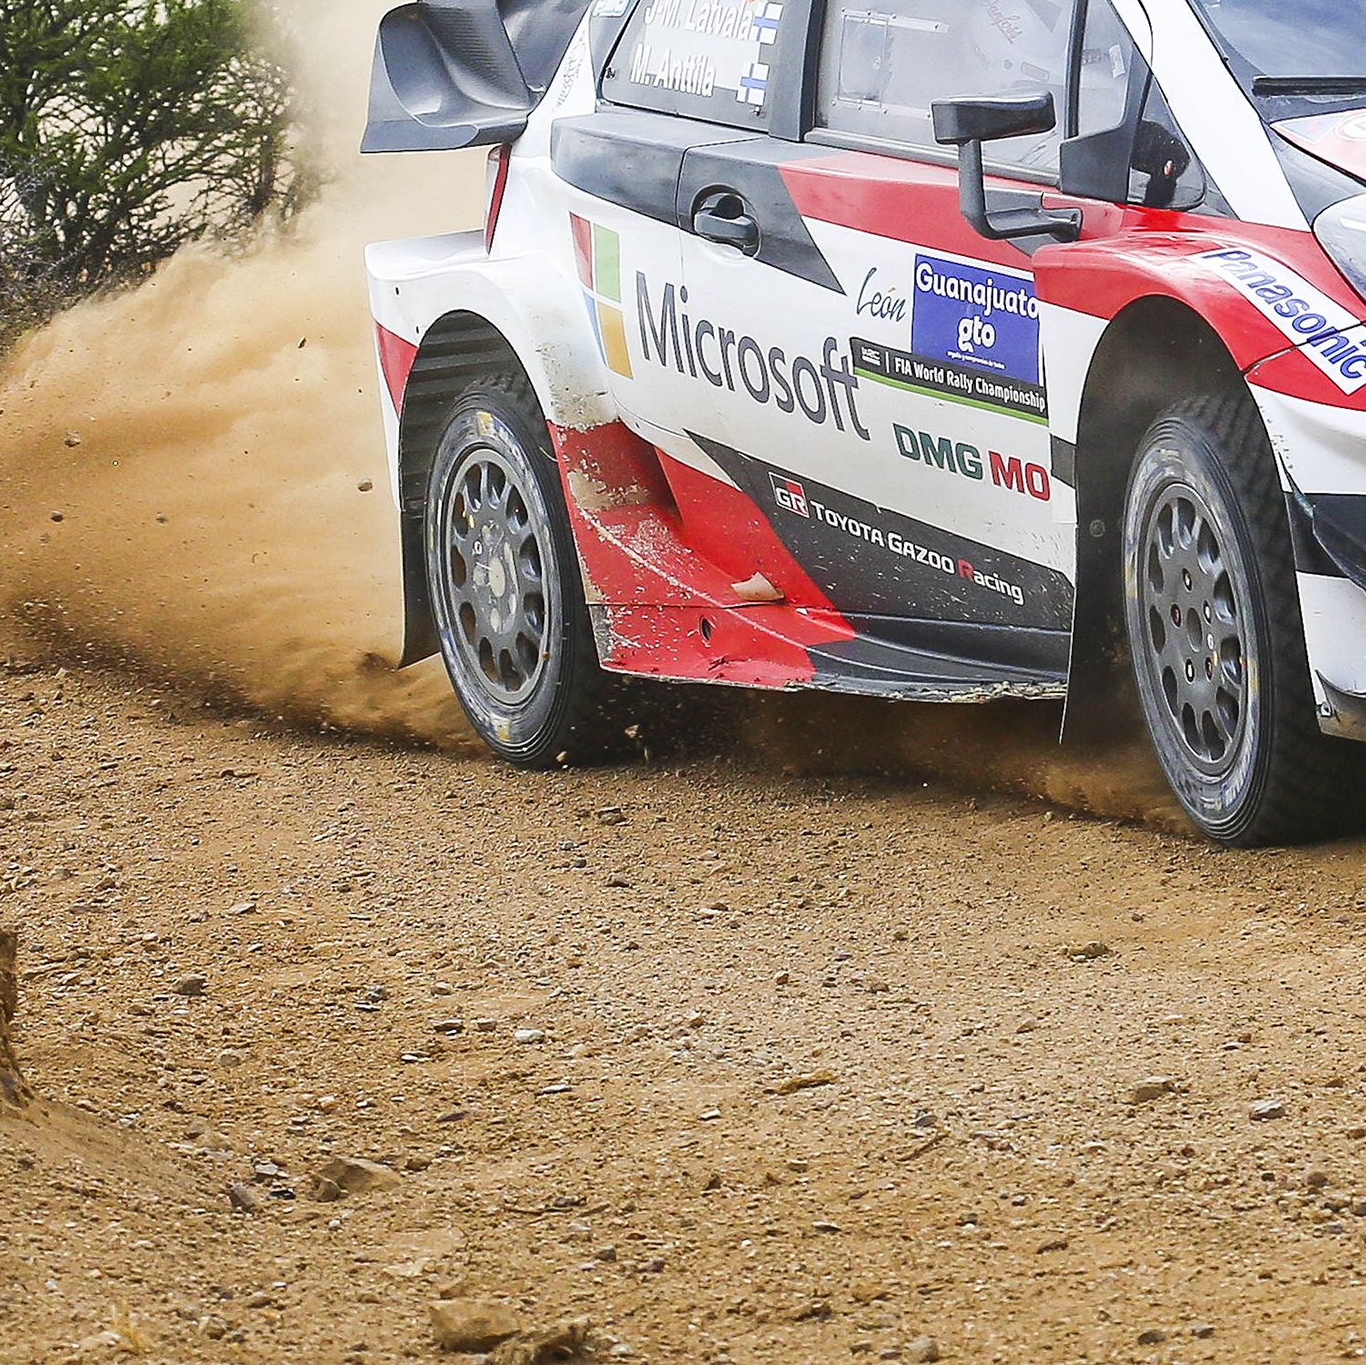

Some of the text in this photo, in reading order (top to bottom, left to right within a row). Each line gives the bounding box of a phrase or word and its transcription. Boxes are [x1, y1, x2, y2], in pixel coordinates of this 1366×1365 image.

[630, 42, 652, 85] M.
[653, 48, 716, 97] Anttila
[856, 267, 907, 322] León
[916, 262, 1040, 318] Guanajuato
[635, 270, 872, 442] Microsoft
[958, 314, 996, 352] gto
[894, 357, 913, 376] FIA
[913, 361, 945, 384] World
[946, 371, 974, 393] Rally
[975, 377, 1046, 412] Championship
[892, 422, 983, 480] DMG
[775, 486, 1025, 605] GR TOYOTA GAZOO Racing
